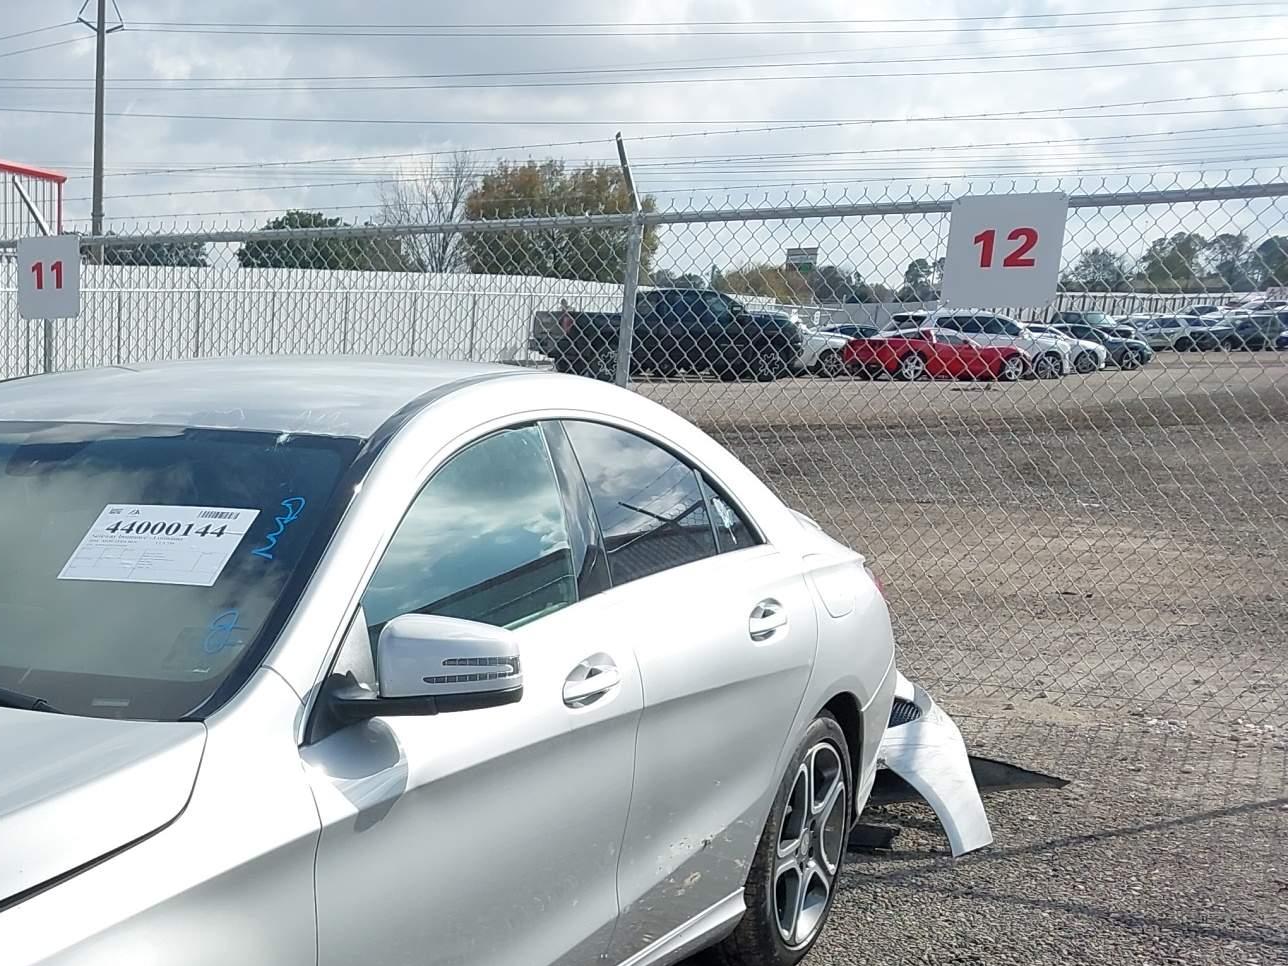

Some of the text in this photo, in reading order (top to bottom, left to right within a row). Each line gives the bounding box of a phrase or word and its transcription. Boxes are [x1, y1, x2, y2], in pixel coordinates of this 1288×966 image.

[974, 226, 1039, 268] 12
[31, 260, 63, 290] 11
[105, 520, 228, 538] 44000144
